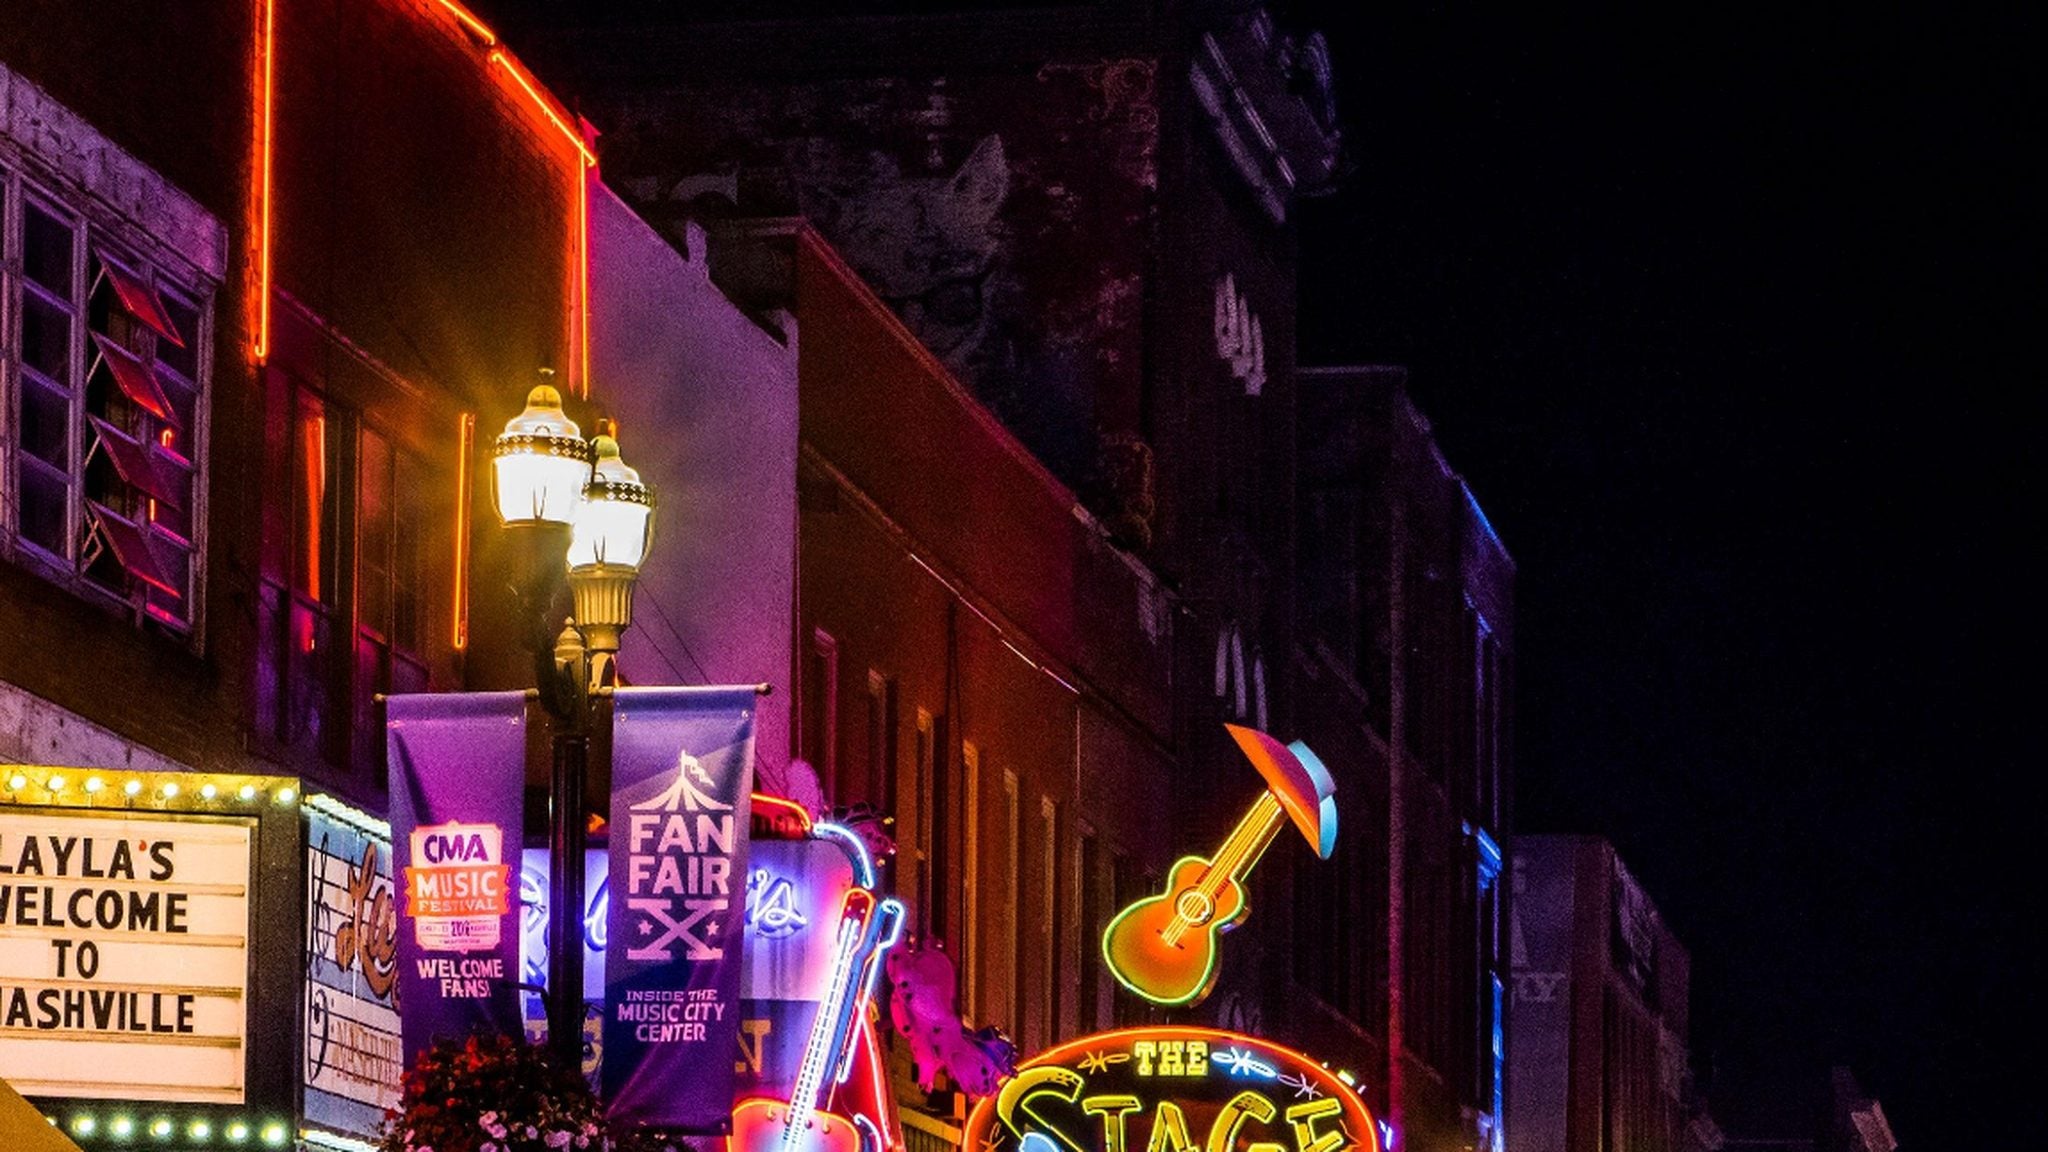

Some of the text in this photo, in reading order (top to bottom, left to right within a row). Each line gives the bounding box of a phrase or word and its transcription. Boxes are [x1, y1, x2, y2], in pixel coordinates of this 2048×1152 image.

[628, 814, 735, 853] FAN
[423, 834, 489, 864] CMA
[416, 870, 498, 899] MUSIC
[628, 855, 730, 895] FAIR
[418, 898, 498, 913] FESTIVAL
[626, 898, 729, 961] X
[52, 938, 99, 980] TO
[416, 958, 504, 979] WELCOME
[441, 978, 492, 998] FANS!
[626, 988, 718, 1002] INSIDE THE
[0, 986, 194, 1034] ASHVILLE
[617, 1002, 725, 1022] MUSIC CITY
[635, 1022, 707, 1042] CENTER
[1133, 1040, 1209, 1076] THE
[997, 1065, 1348, 1152] STAGE
